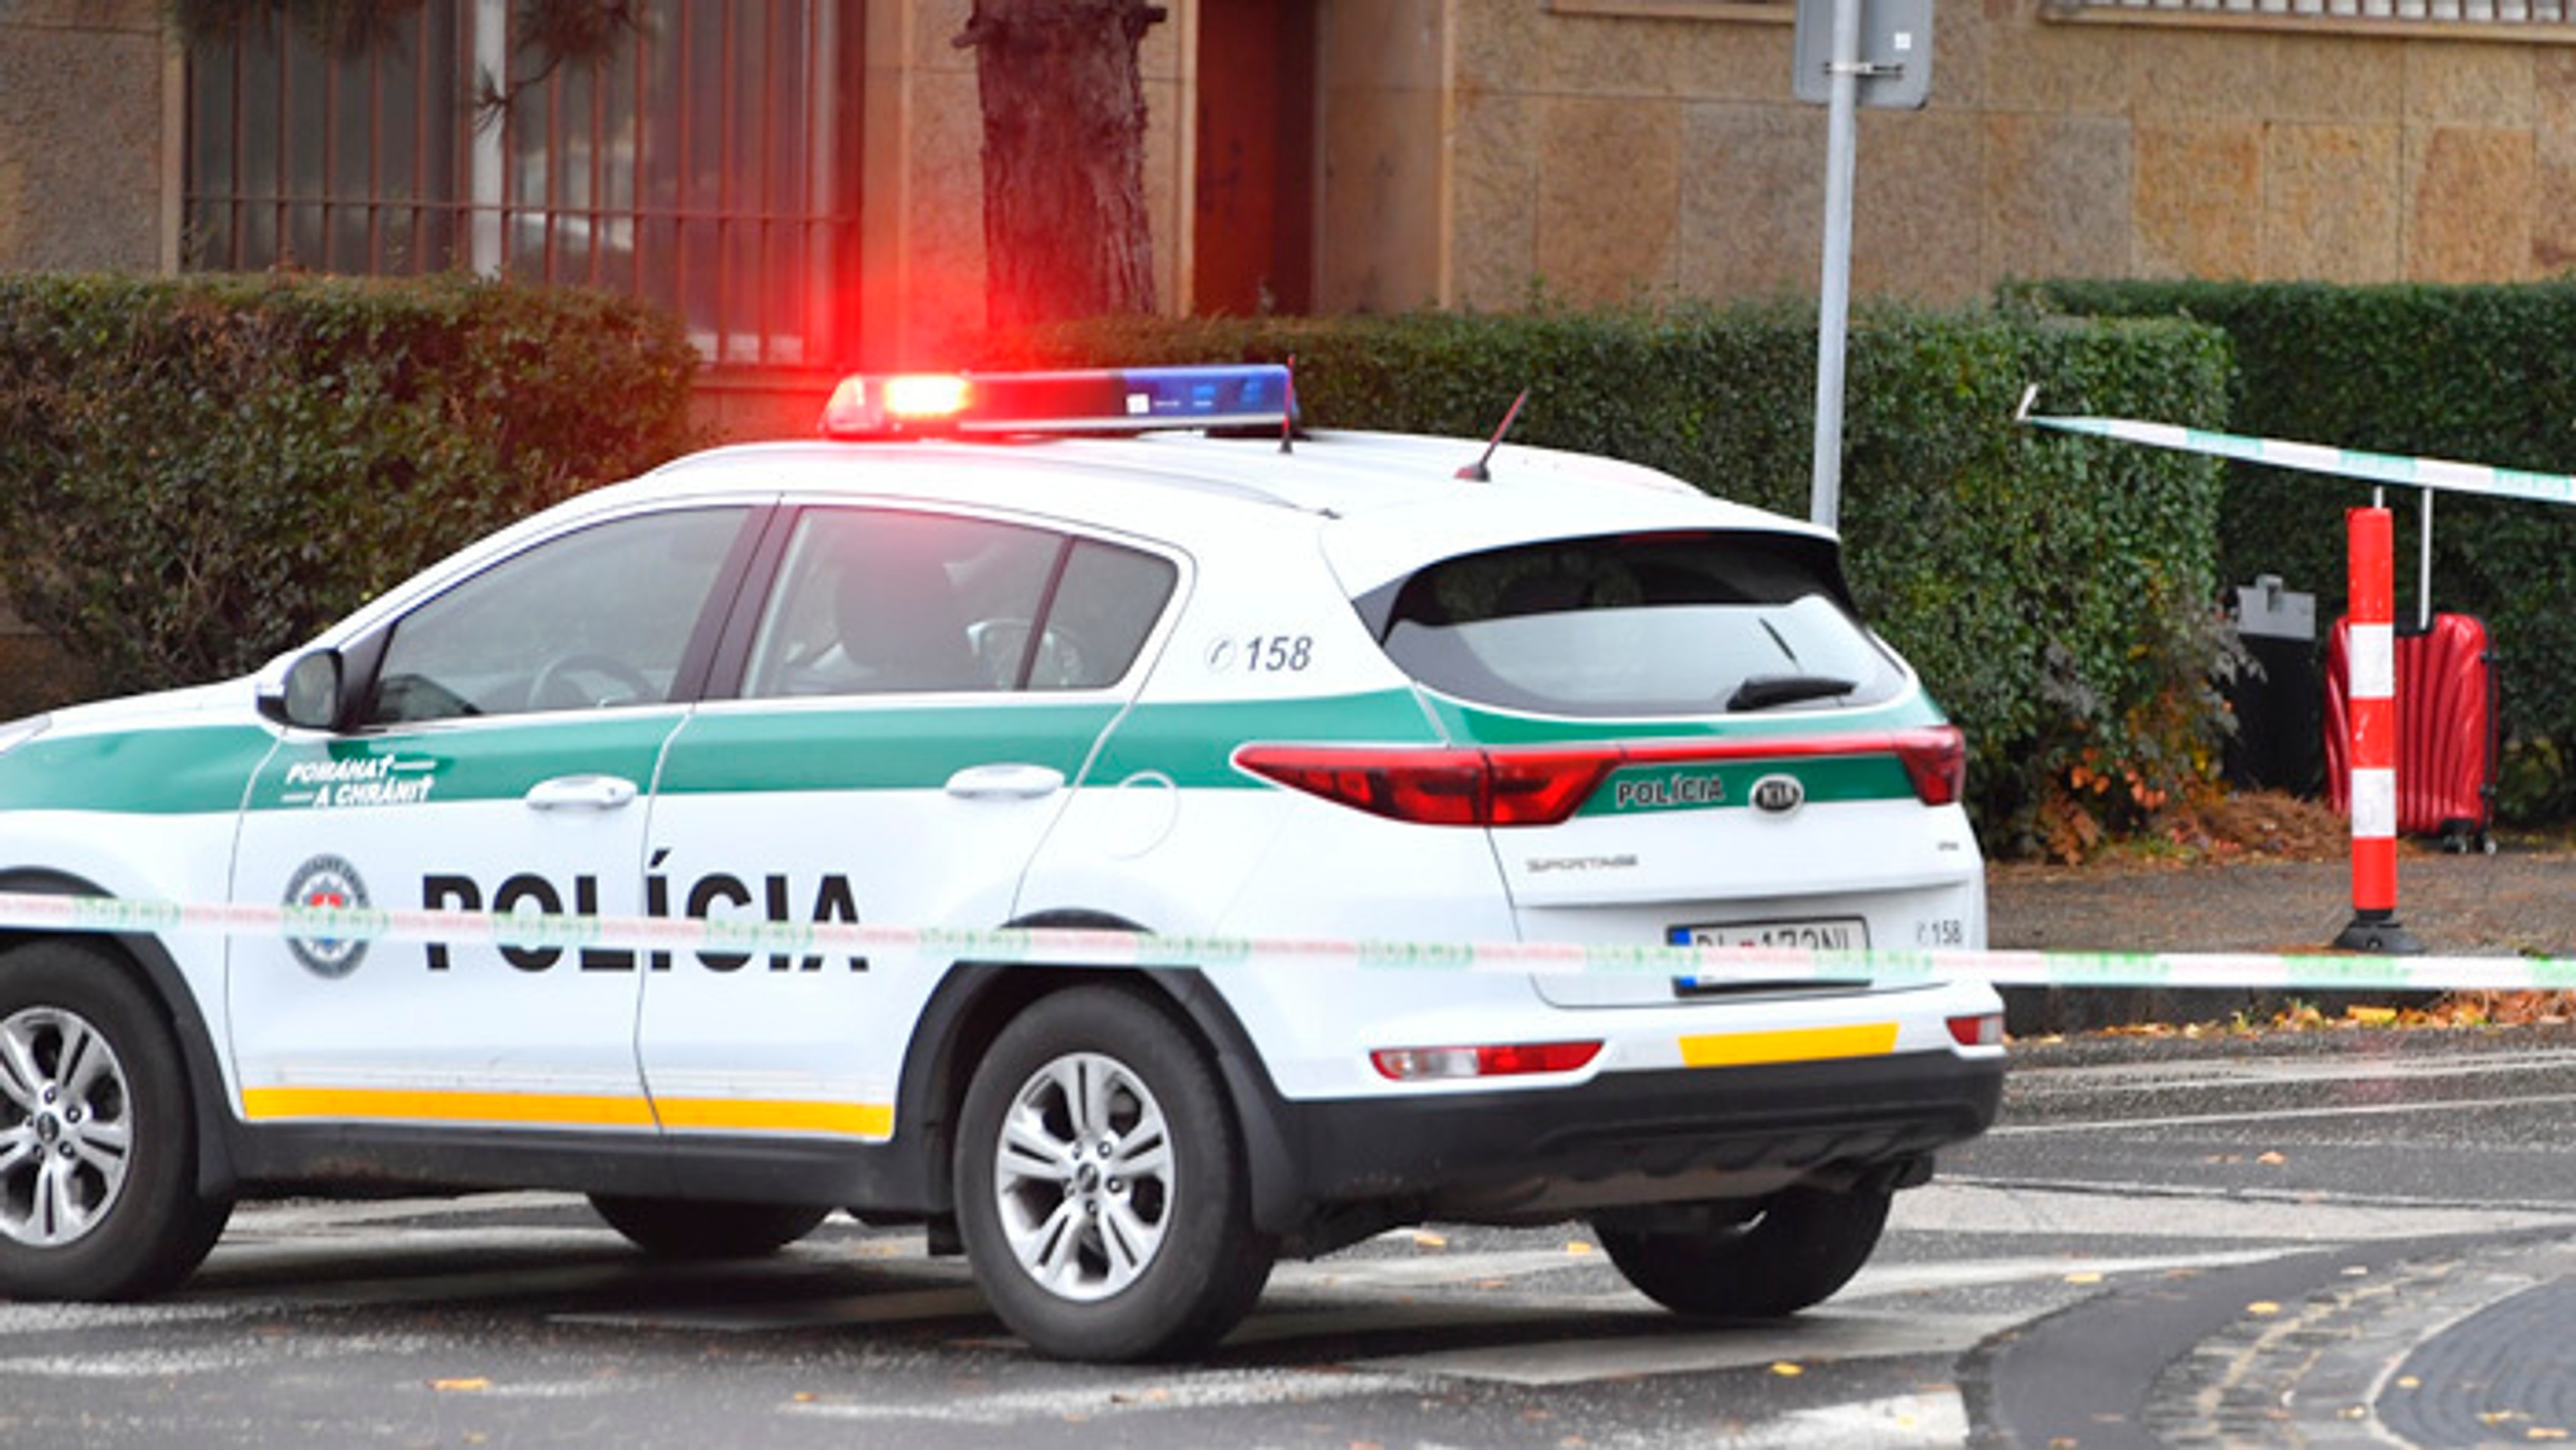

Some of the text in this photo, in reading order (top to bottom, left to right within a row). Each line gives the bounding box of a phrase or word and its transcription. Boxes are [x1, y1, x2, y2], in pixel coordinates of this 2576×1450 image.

[1247, 636, 1314, 671] 158
[313, 784, 330, 809] A
[1615, 773, 1726, 809] POLÍCIA
[422, 848, 870, 973] POLÍCIA
[1931, 919, 1963, 945] 158
